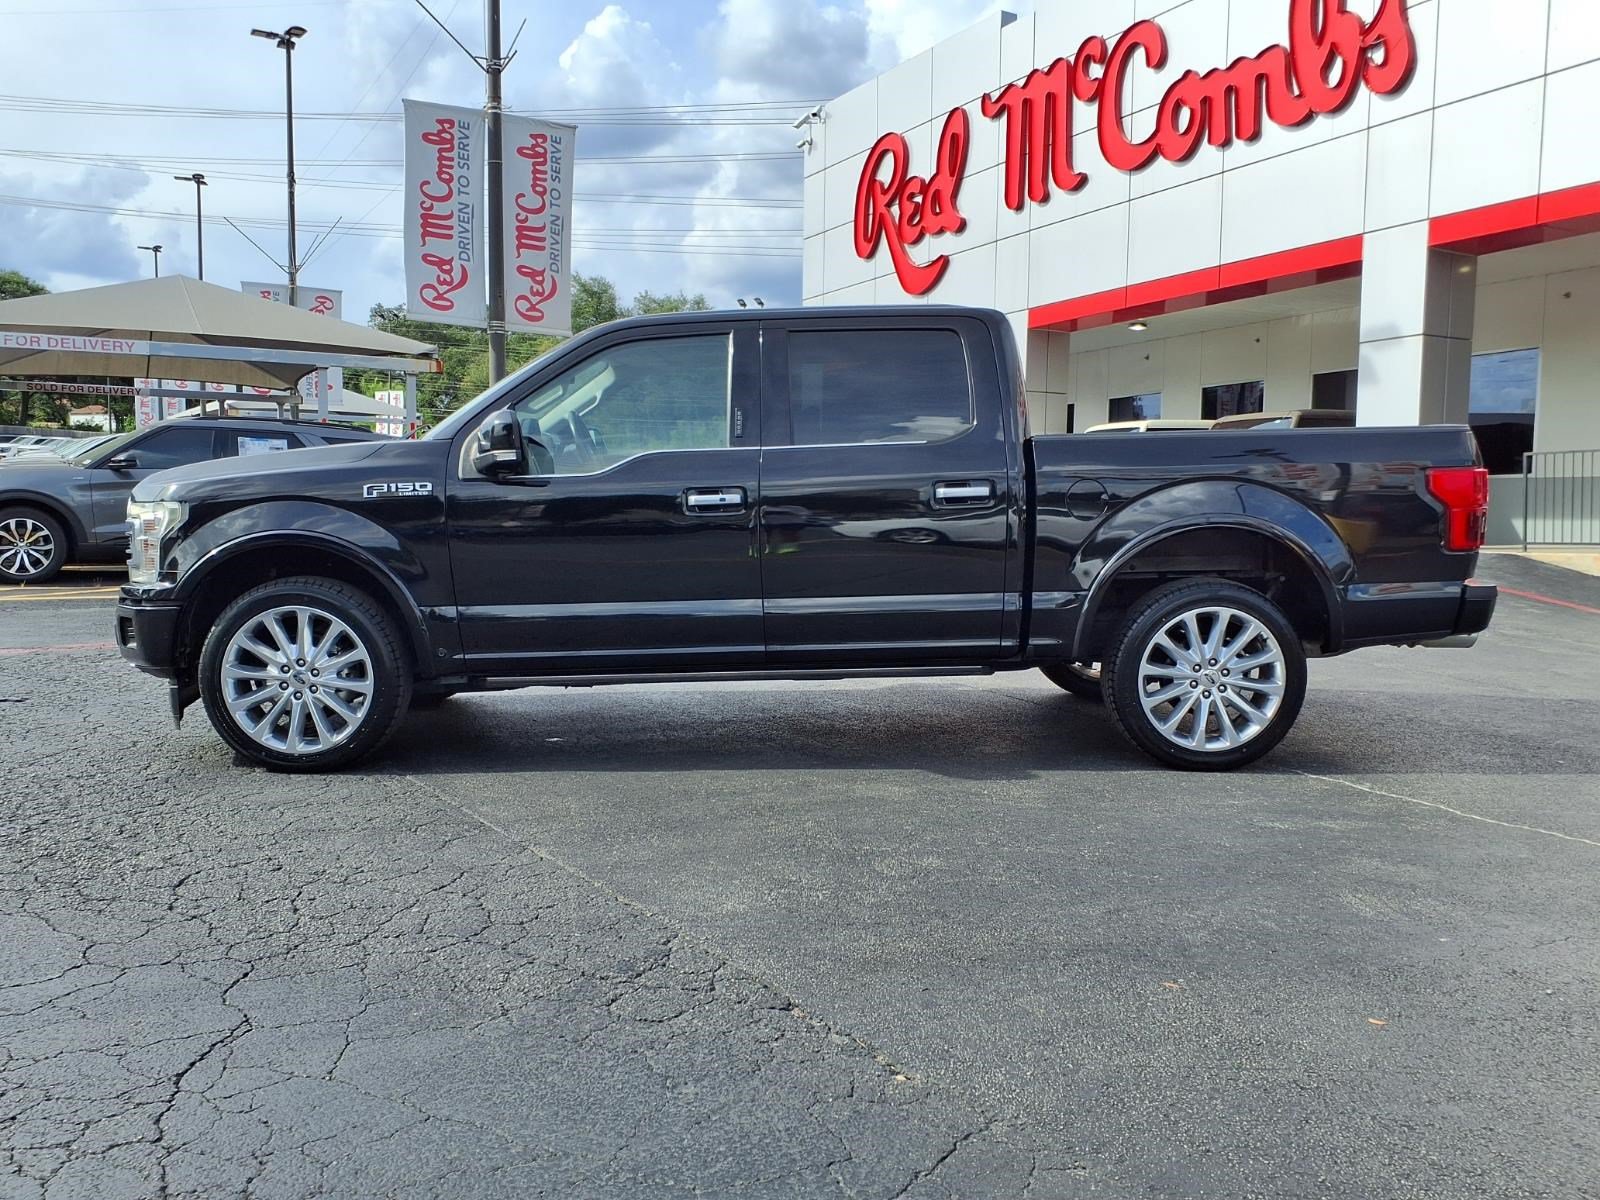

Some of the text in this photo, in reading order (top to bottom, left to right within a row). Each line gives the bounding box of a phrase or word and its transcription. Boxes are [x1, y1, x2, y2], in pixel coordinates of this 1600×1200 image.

[419, 118, 470, 312] Red McCombs
[457, 119, 472, 263] DRIVEN TO SERVE
[550, 134, 562, 274] DRIVEN TO SERVE
[855, 0, 1416, 295] Red McCombs
[514, 132, 558, 323] Red McCombs
[3, 334, 136, 352] FOR DELIVERY
[26, 382, 141, 395] SOLD FOR DELIVERY
[305, 373, 314, 399] ERVE
